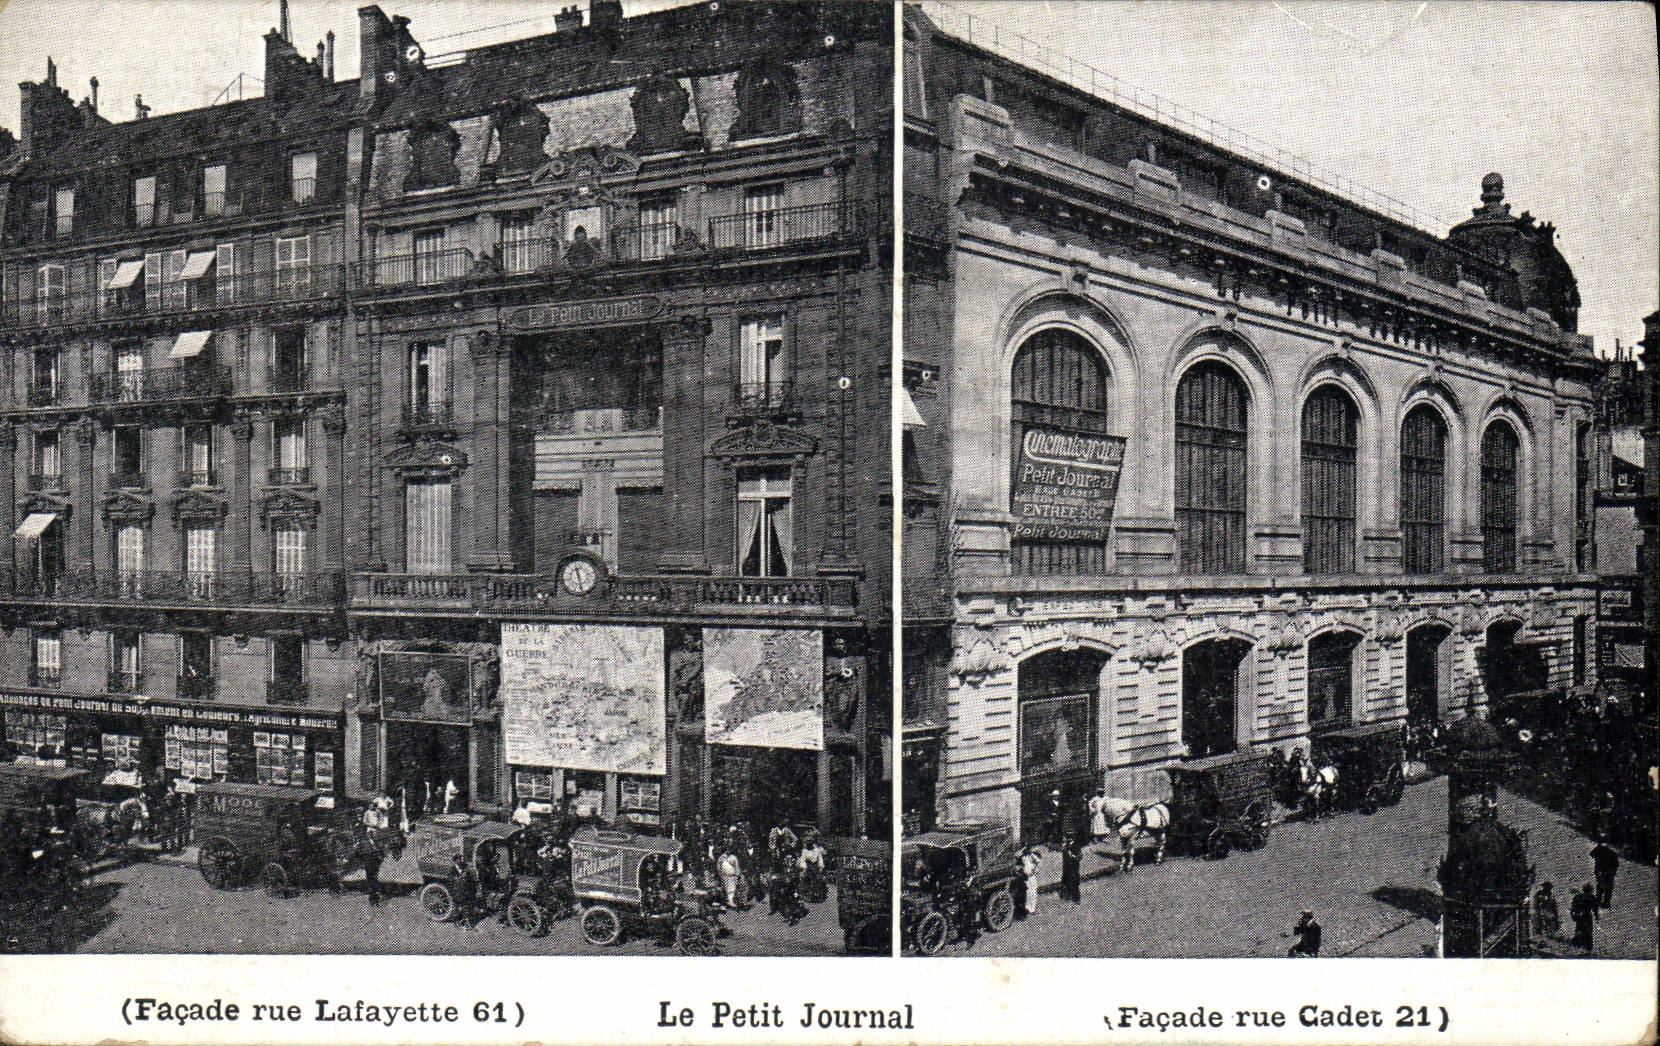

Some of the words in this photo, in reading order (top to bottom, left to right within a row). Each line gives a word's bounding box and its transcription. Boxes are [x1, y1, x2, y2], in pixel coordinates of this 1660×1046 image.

[528, 308, 545, 326] Le
[550, 305, 582, 323] Petit
[588, 299, 644, 320] Journal
[1022, 463, 1056, 484] Petit
[1057, 466, 1117, 489] Journal
[1013, 524, 1046, 538] Petit
[1049, 525, 1105, 541] Journal
[533, 638, 545, 646] LA
[506, 649, 548, 660] GUERRE
